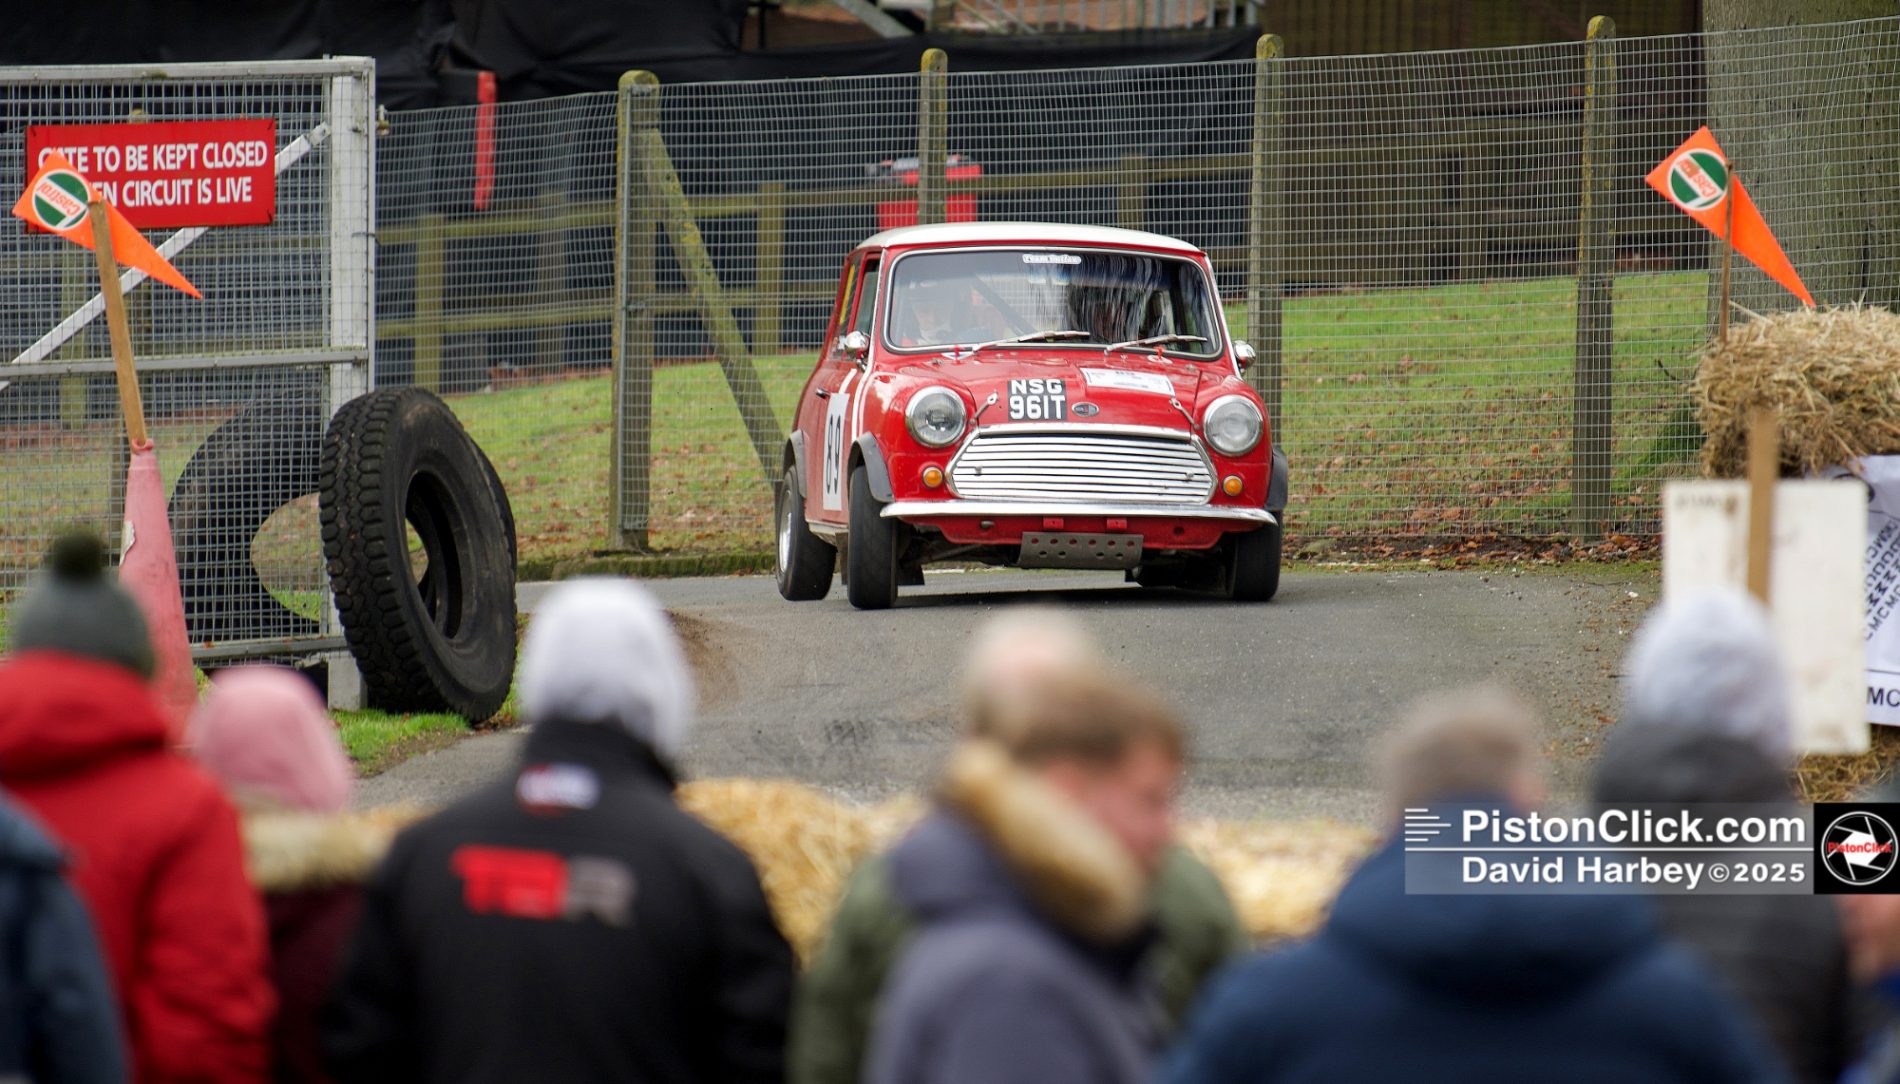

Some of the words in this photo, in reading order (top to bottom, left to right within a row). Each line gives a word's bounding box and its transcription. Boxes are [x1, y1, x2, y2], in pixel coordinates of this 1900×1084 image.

[93, 145, 121, 173] TO
[125, 144, 149, 172] BE
[153, 142, 199, 171] KEPT
[202, 140, 268, 169] CLOSED
[36, 181, 81, 217] Castrol
[122, 178, 193, 208] CIRCUIT
[197, 177, 213, 205] IS
[216, 175, 253, 204] LIVE
[1010, 379, 1063, 394] NSG
[1009, 395, 1066, 420] 961T
[826, 414, 841, 494] 89
